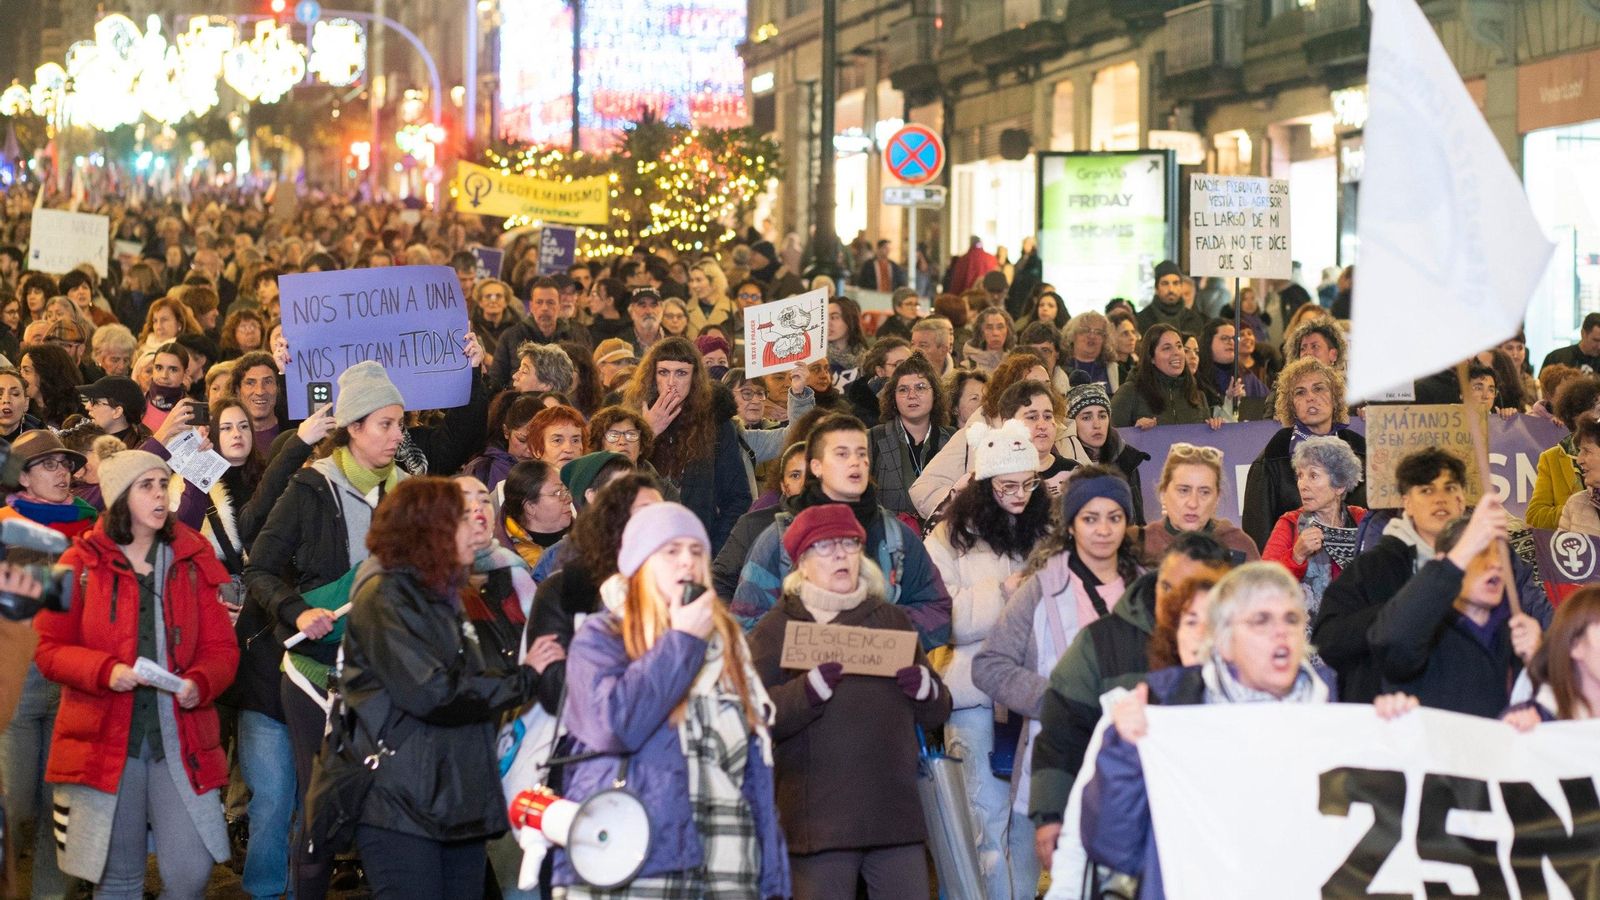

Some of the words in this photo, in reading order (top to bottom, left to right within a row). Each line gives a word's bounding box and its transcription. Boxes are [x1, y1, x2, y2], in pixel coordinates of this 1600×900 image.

[1194, 179, 1220, 191] NADIE
[1226, 180, 1262, 194] PREGUNTA
[1269, 181, 1289, 195] CÓMO
[1069, 194, 1134, 207] FRIDAY
[1252, 196, 1282, 208] AGRESOR
[1194, 212, 1208, 227] EL
[1214, 211, 1245, 226] LARGO
[1252, 212, 1264, 227] DE
[1195, 235, 1226, 250] FALDA
[1231, 235, 1246, 249] NO
[1251, 236, 1263, 250] TE
[1218, 254, 1234, 270] QUE
[293, 295, 337, 324] NOS
[339, 286, 400, 321] TOCAN
[405, 285, 418, 313] A
[425, 282, 457, 311] UNA
[338, 341, 394, 369] TOCAN
[399, 329, 469, 371] TODAS
[399, 339, 409, 369] A
[297, 346, 335, 383] NOS
[1383, 407, 1462, 430] MÁTANOS
[1378, 433, 1404, 446] SEN
[1410, 431, 1450, 446] SABER
[1456, 432, 1474, 446] QU
[794, 625, 818, 646] EL
[785, 647, 807, 662] ES
[1318, 766, 1600, 900] 25N
